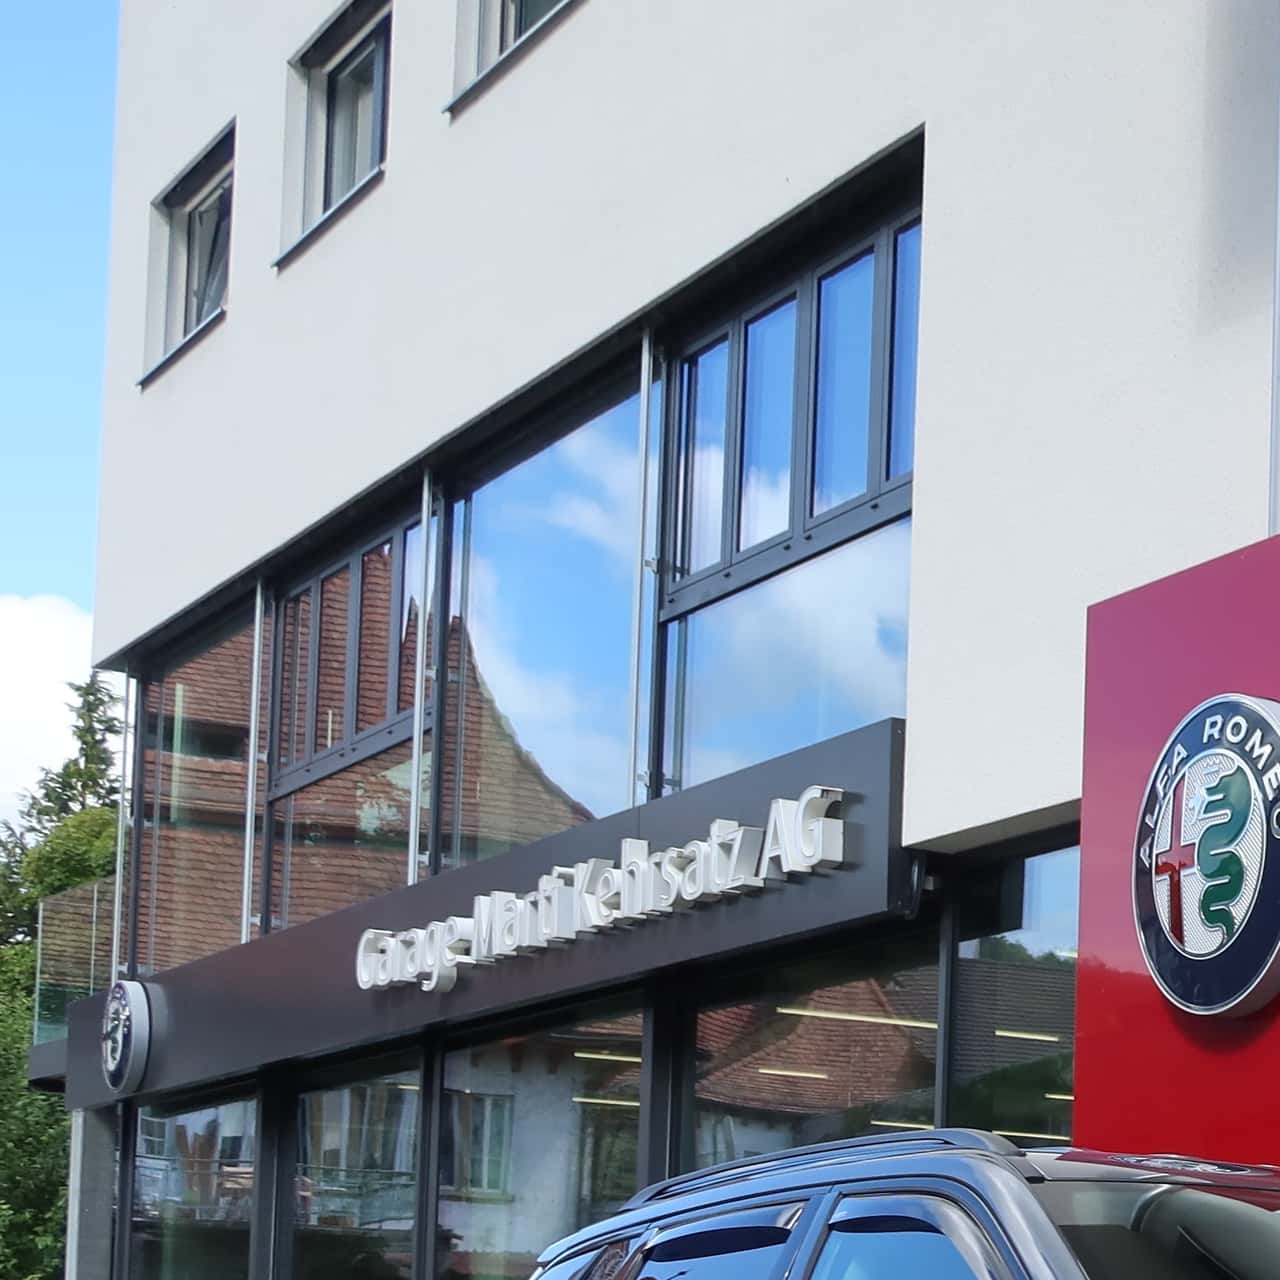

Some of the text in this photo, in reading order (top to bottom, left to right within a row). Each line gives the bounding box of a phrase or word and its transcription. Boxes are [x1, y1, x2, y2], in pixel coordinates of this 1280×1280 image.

[356, 917, 472, 993] Garage
[575, 819, 764, 931] Kehrsatz
[760, 785, 845, 873] AG
[1139, 743, 1189, 869] ALFA
